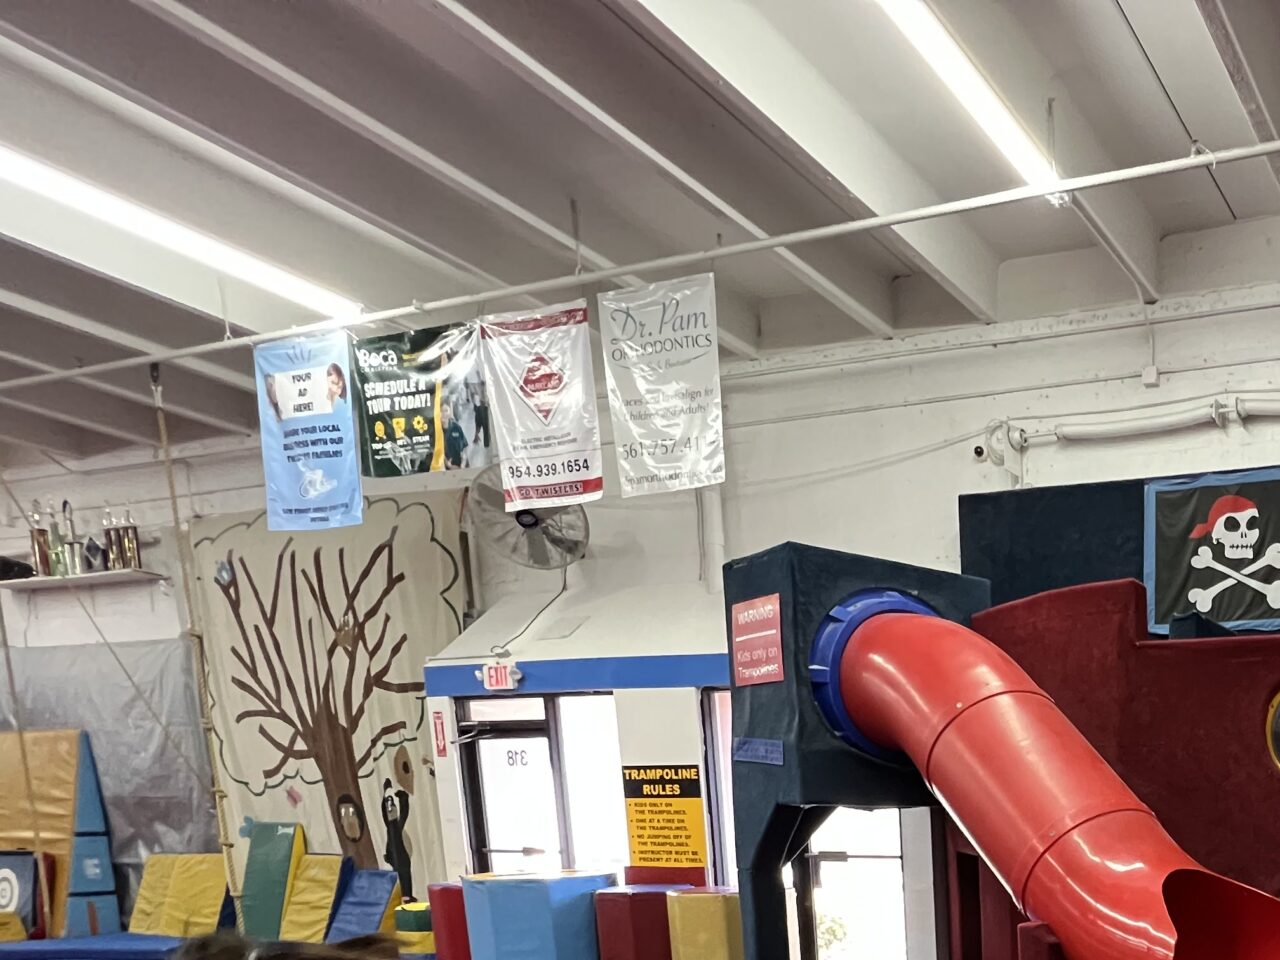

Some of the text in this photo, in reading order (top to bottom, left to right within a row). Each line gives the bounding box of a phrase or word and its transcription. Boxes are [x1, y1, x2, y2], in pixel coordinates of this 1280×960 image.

[610, 306, 652, 345] Dr.
[659, 297, 709, 335] Pam
[611, 333, 712, 362] ORODONTICS
[359, 348, 398, 368] Boca
[292, 372, 311, 383] YOUR
[298, 388, 307, 397] AD
[363, 379, 416, 398] SCHEDULE
[293, 402, 313, 413] HERE!
[366, 393, 431, 415] TOUR TODAY!
[319, 424, 341, 433] LOCAL
[508, 458, 590, 479] 954.939.1654
[520, 488, 531, 497] GO
[737, 604, 774, 625] WARNING
[737, 647, 778, 662] Kids only on
[488, 665, 508, 687] EXIT
[623, 768, 698, 780] TRAMPOLINE
[643, 784, 680, 795] RULES
